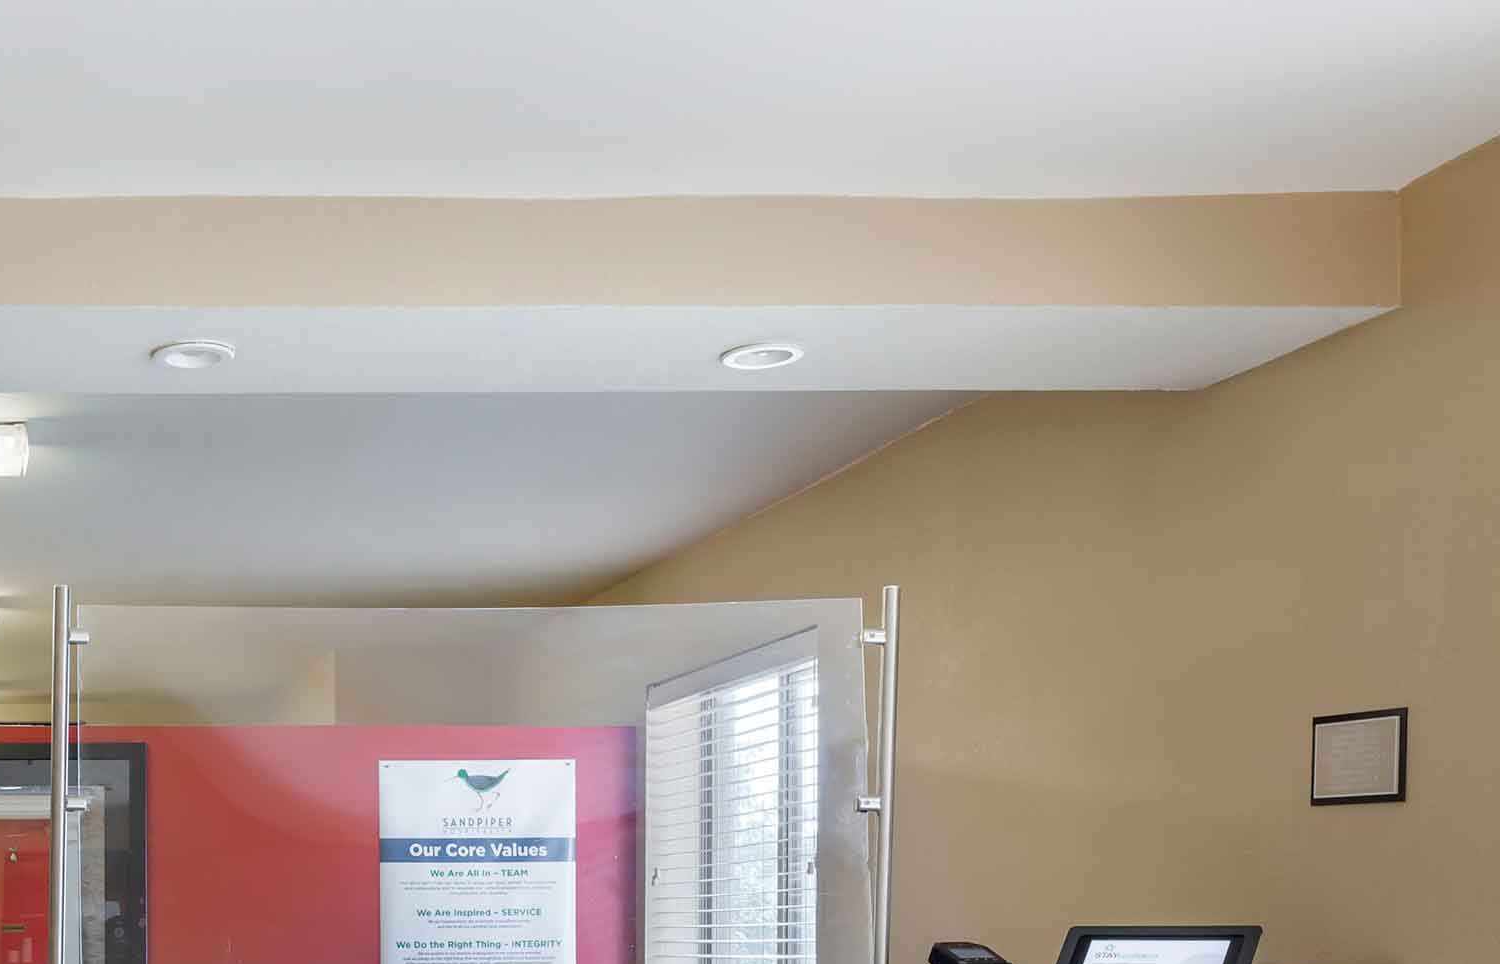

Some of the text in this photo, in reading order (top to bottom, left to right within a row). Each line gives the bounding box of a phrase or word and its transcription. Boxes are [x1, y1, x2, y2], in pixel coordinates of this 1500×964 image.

[443, 817, 513, 827] SANDPIPER
[409, 842, 548, 857] Our Core Values
[430, 869, 445, 877] We
[448, 869, 464, 877] Are
[467, 869, 481, 877] All
[482, 869, 491, 877] In
[501, 869, 529, 877] TEAM
[417, 909, 433, 917] We
[435, 909, 451, 917] Are
[454, 908, 491, 919] Inspired
[501, 908, 542, 916] SERVICE
[396, 941, 411, 949] We
[414, 941, 427, 949] Do
[430, 941, 445, 949] the
[448, 940, 473, 951] Right
[475, 940, 501, 951] Thing
[512, 940, 563, 948] INTEGRITY
